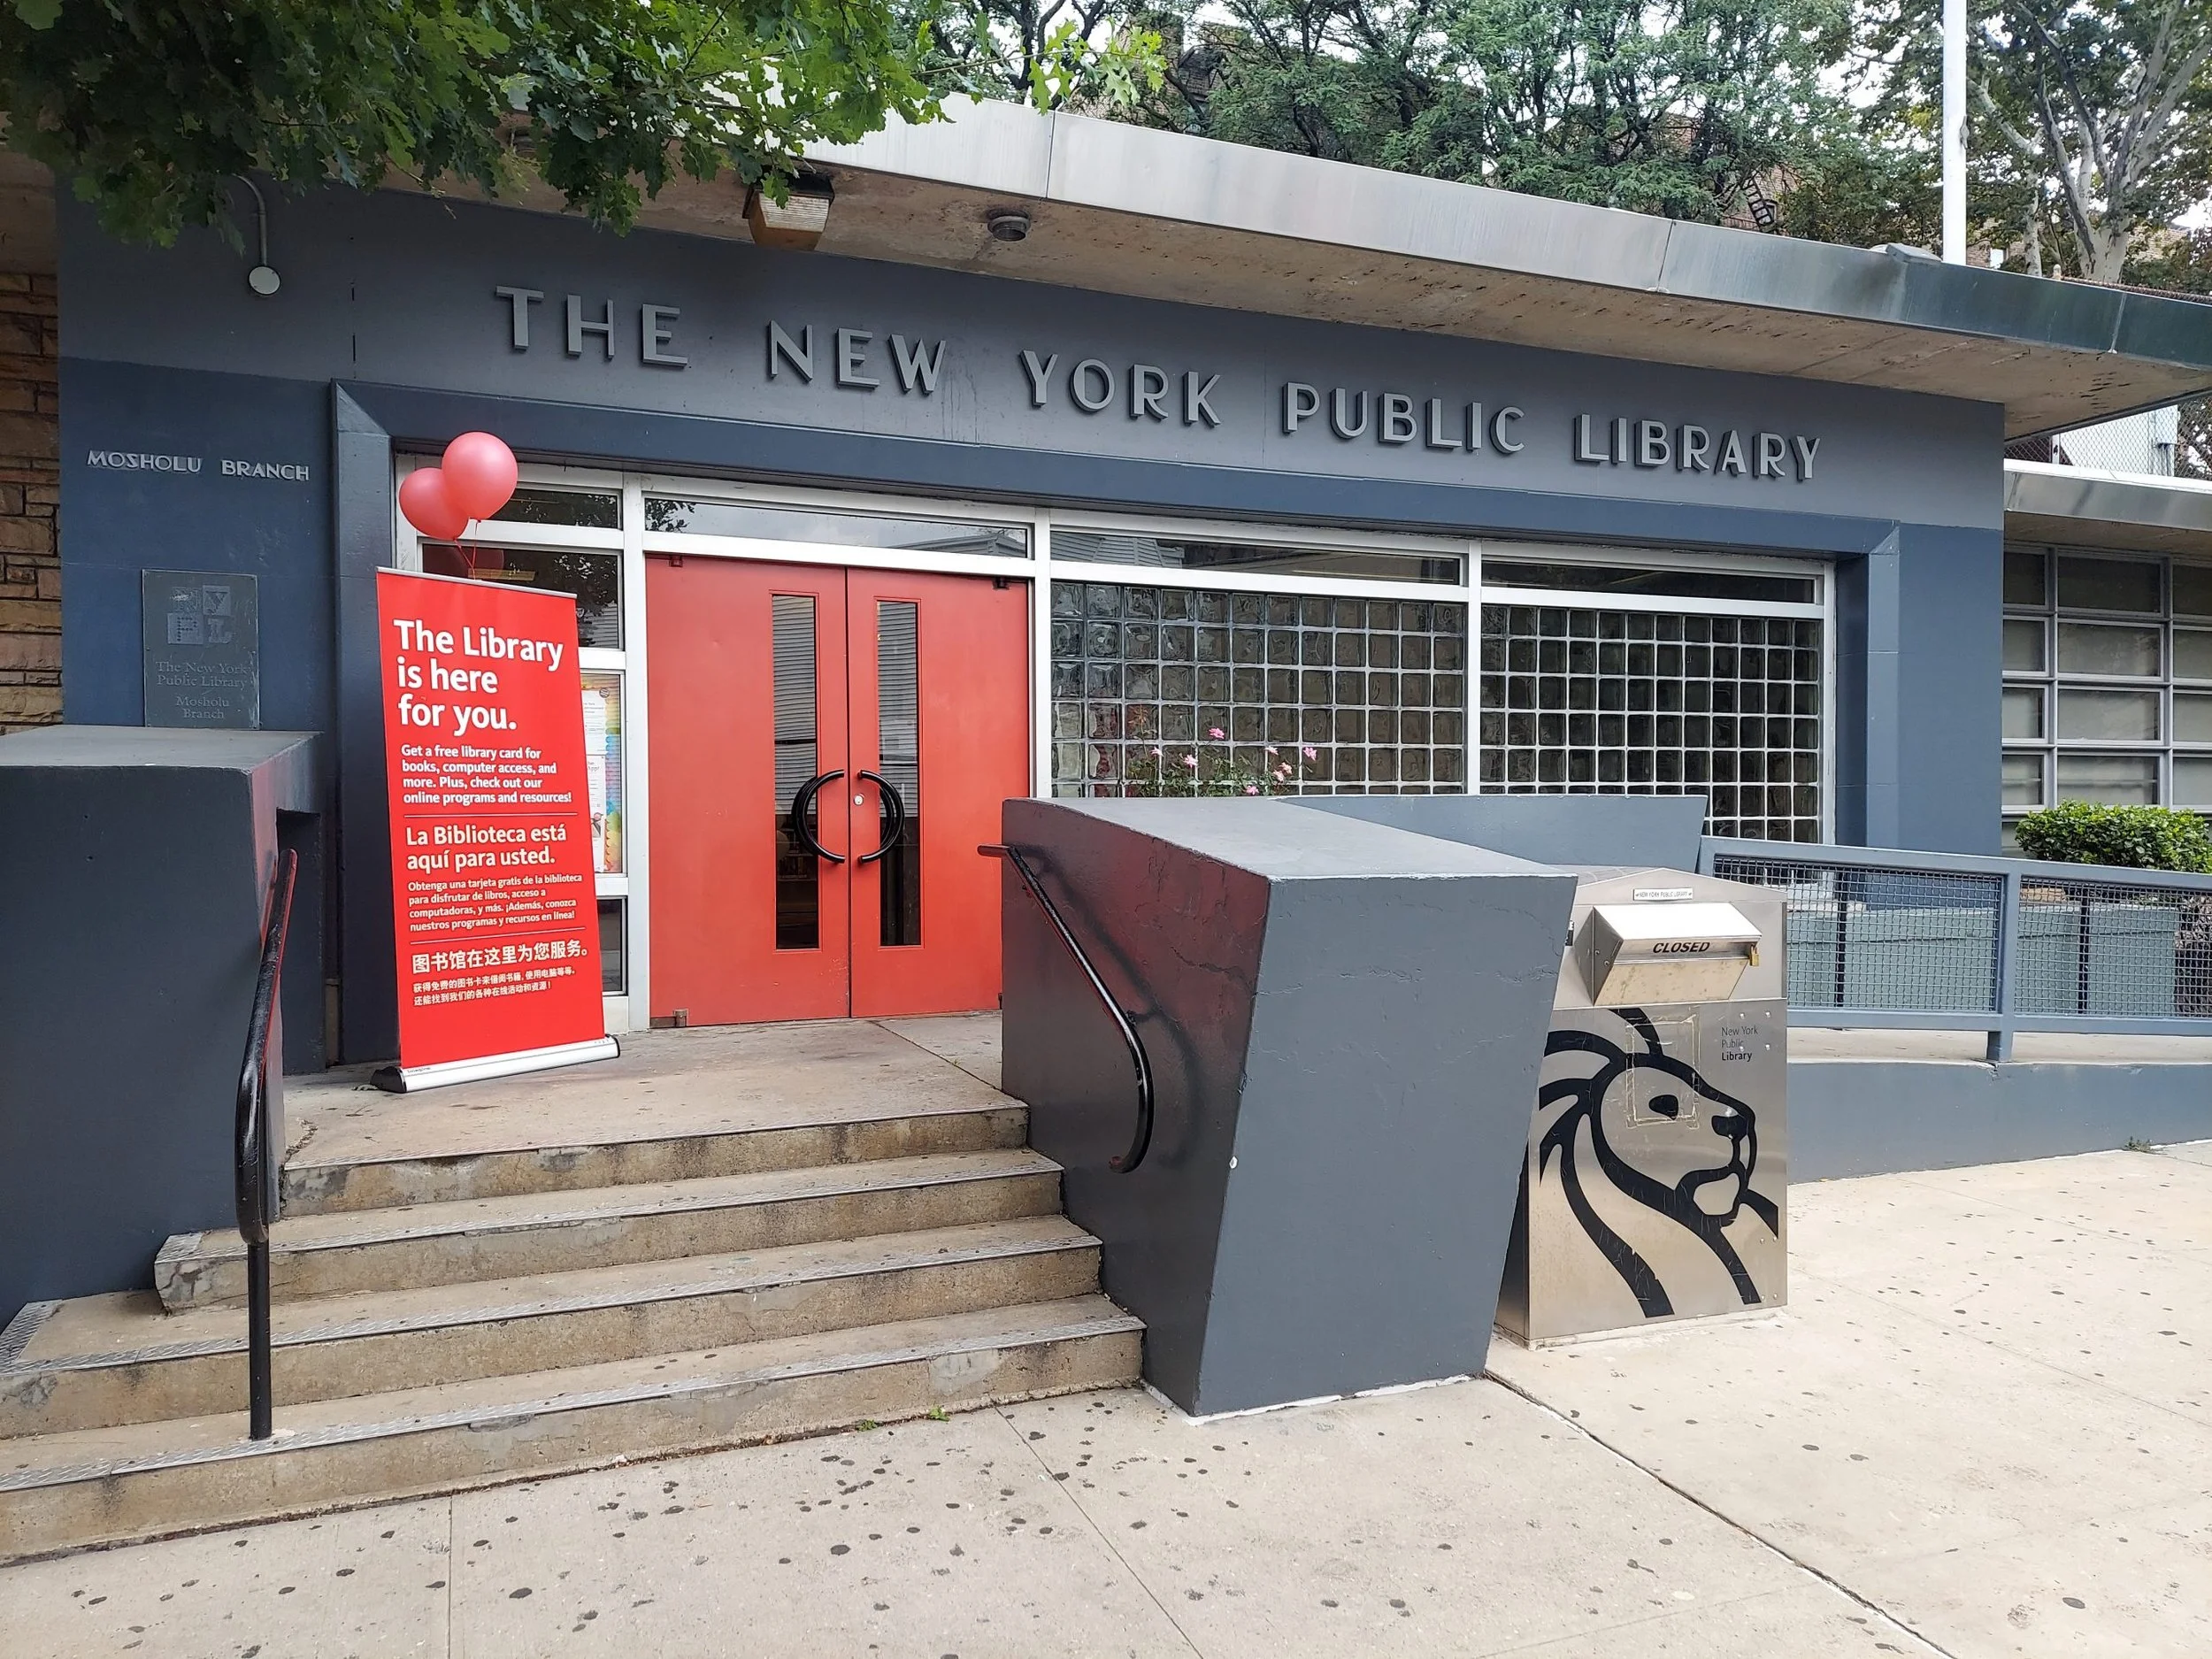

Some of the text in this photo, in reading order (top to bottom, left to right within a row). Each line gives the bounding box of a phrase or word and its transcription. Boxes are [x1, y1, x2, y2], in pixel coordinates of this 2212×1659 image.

[495, 285, 1821, 481] THE NEW YORK PUBLIC LIBRARY
[87, 450, 310, 480] MOSHOLU BRANCH
[394, 619, 563, 671] The Library
[156, 661, 248, 674] The New York
[397, 657, 497, 693] is here
[157, 675, 247, 690] Public Library
[176, 696, 229, 707] Mosholu
[184, 709, 224, 718] Branch
[398, 694, 517, 736] for you.
[402, 745, 541, 761] Get a free library card for
[403, 759, 557, 775] books, computer access, and
[403, 779, 436, 787] more.
[440, 776, 467, 789] Plus,
[470, 776, 501, 787] check
[503, 778, 521, 787] out
[403, 791, 572, 806] online programs and resources!
[407, 824, 566, 845] La Biblioteca está
[408, 846, 555, 873] aquí para usted.
[409, 882, 447, 892] Obtenga
[468, 879, 496, 889] tarjeta
[498, 877, 521, 888] gratis
[545, 874, 581, 883] biblioteca
[409, 897, 428, 907] para
[431, 894, 470, 902] disfrutar
[410, 906, 475, 918] computadoras,
[506, 901, 543, 912] ¡Además,
[411, 922, 449, 931] nuestros
[452, 918, 497, 930] programas
[499, 918, 503, 926] y
[554, 910, 574, 919] línea!
[1653, 941, 1710, 954] CLOSED
[412, 939, 588, 974] 图书馆在这里为您服务。
[1721, 1025, 1758, 1036] New York
[1721, 1040, 1745, 1048] Public
[1721, 1052, 1752, 1062] Library
